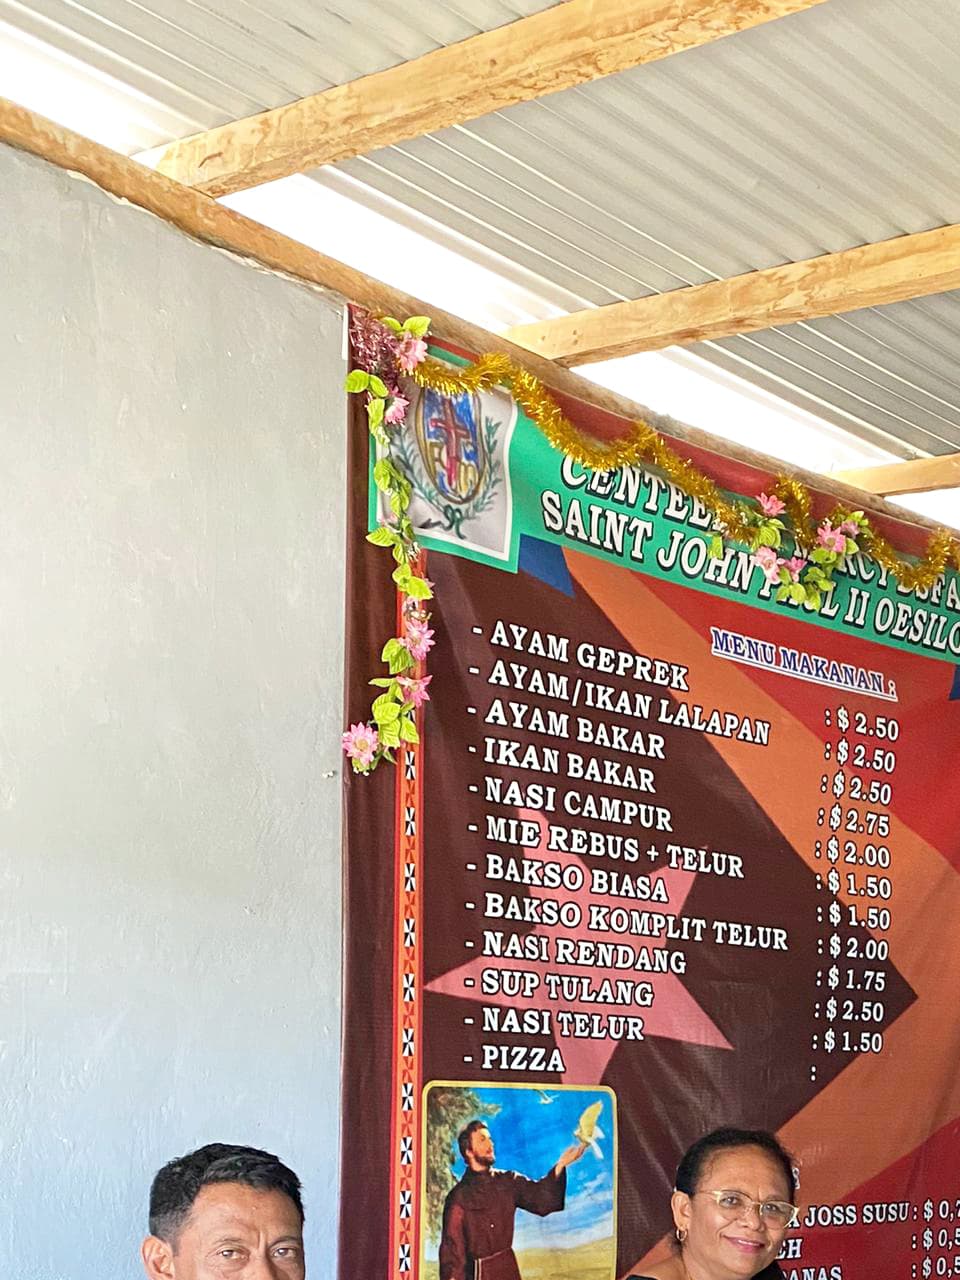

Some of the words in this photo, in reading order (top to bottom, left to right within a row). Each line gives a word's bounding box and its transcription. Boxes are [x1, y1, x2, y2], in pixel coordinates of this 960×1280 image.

[562, 454, 727, 531] CENTEE
[542, 490, 652, 560] SAINT
[658, 531, 755, 591] JOHN
[845, 587, 871, 626] II
[490, 620, 569, 663] AYAM
[577, 643, 689, 690] GEPREK
[855, 712, 899, 741] 2.50
[711, 627, 776, 665] MENU
[781, 647, 884, 693] MAKANAN
[484, 699, 569, 738] AYAM
[577, 717, 665, 759] BAKAR
[850, 777, 892, 805] 2.50
[488, 660, 652, 719] AYAM/IKAN
[658, 699, 769, 745] LALAPAN
[853, 744, 895, 773] 2.50
[484, 737, 560, 774] IKAN
[567, 752, 656, 794] BAKAR
[846, 810, 889, 837] 2.75
[484, 776, 556, 812] NASI
[564, 790, 673, 832] CAMPUR
[845, 842, 890, 868] 2.00
[485, 853, 587, 892] BAKSO
[590, 869, 671, 902] BIASA
[848, 906, 891, 930] 1.50
[486, 816, 541, 847] MIE
[549, 825, 638, 861] REBUS
[666, 844, 745, 878] TELUR
[847, 874, 891, 899] 1.50
[482, 930, 549, 962] NASI
[556, 936, 687, 975] RENDANG
[846, 969, 885, 992] 1.75
[484, 892, 584, 929] BAKSO
[588, 905, 707, 944] KOMPLIT
[712, 920, 788, 951] TELUR
[846, 937, 888, 961] 2.00
[482, 969, 540, 1000] SUP
[545, 974, 654, 1006] TULANG
[842, 1000, 884, 1022] 2.50
[482, 1007, 551, 1035] NASI
[557, 1010, 644, 1041] TELUR
[842, 1031, 882, 1053] 1.50
[482, 1045, 565, 1072] PIZZA
[804, 1205, 857, 1227] JOSS
[862, 1202, 909, 1224] SUSU
